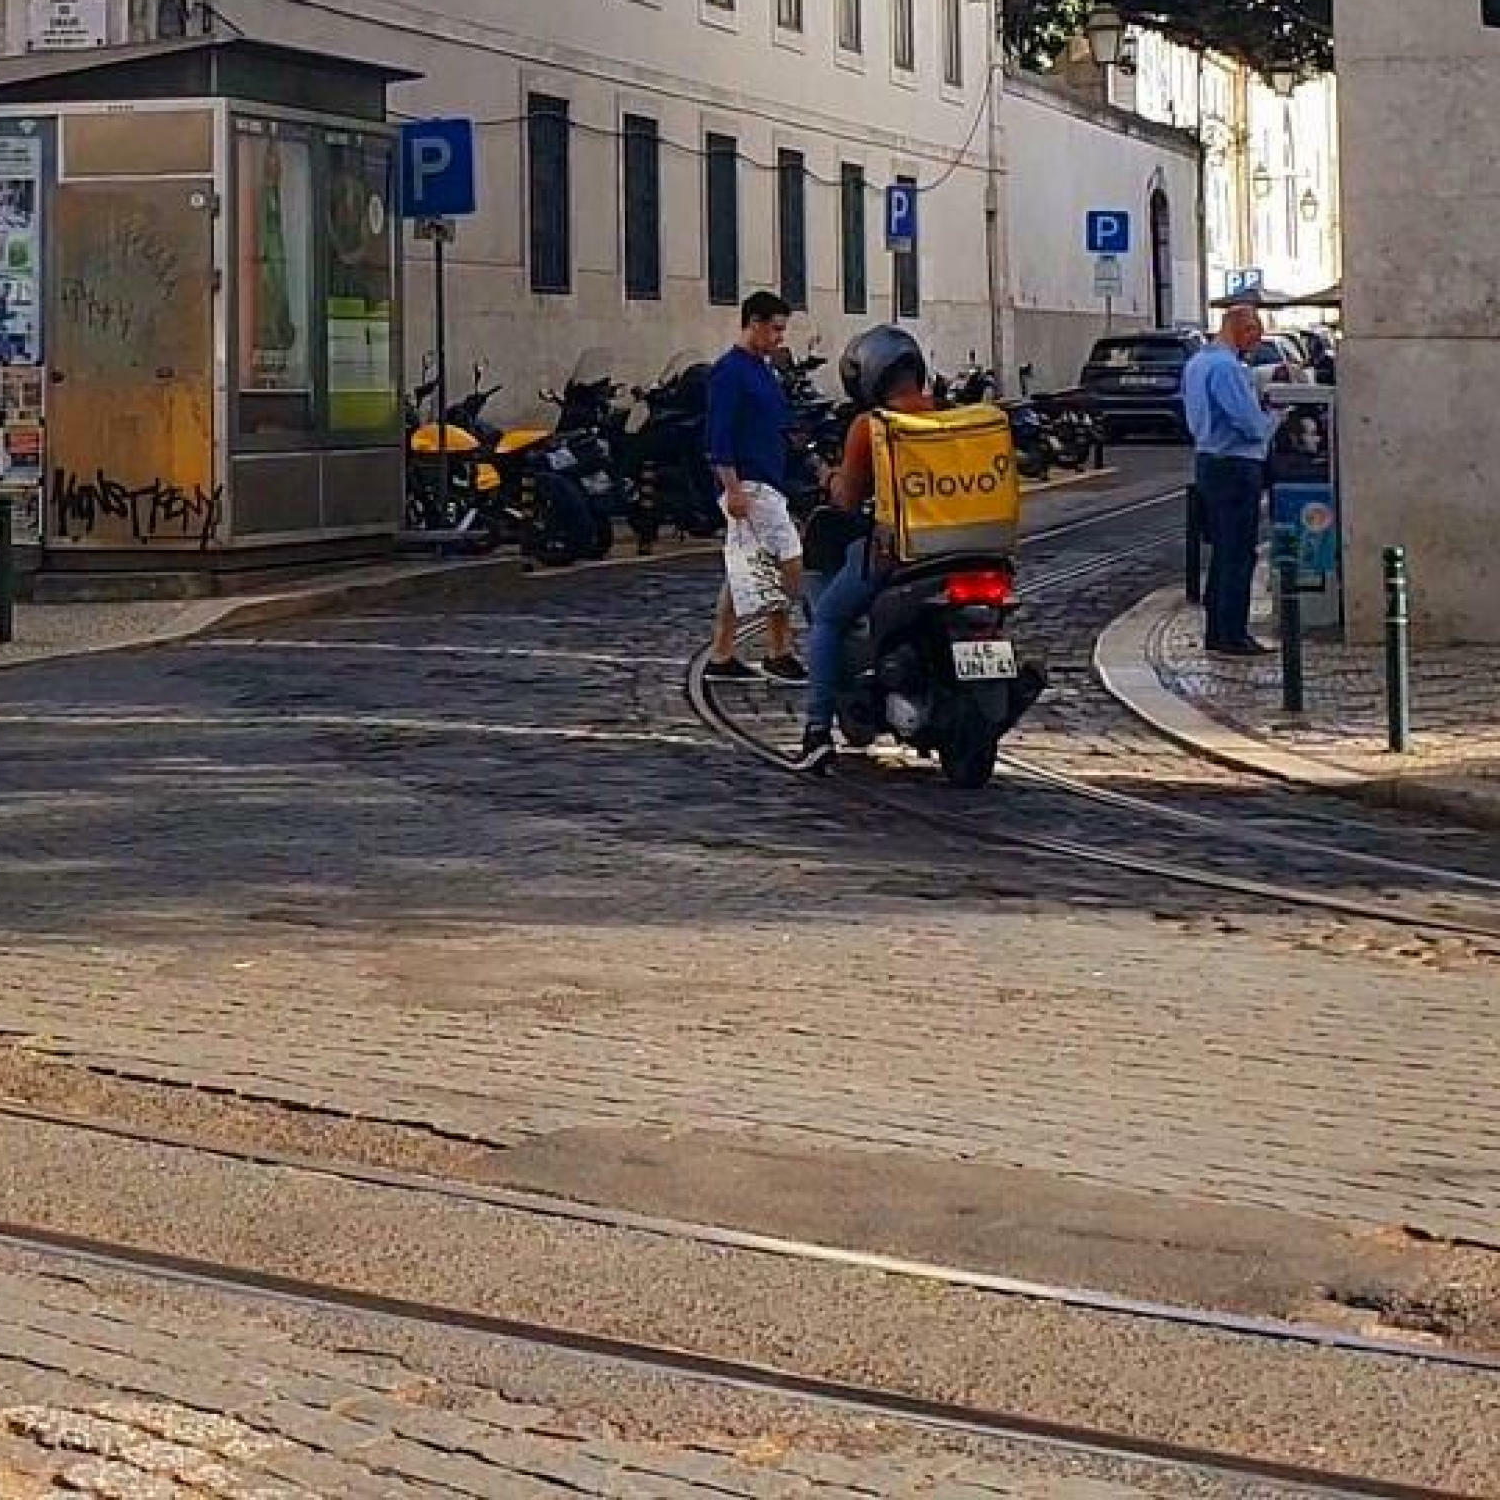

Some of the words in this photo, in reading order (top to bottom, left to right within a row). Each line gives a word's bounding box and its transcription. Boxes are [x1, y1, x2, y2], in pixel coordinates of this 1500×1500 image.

[411, 138, 451, 200] P
[891, 191, 909, 235] P
[1097, 216, 1118, 249] P
[901, 471, 998, 498] Glovo
